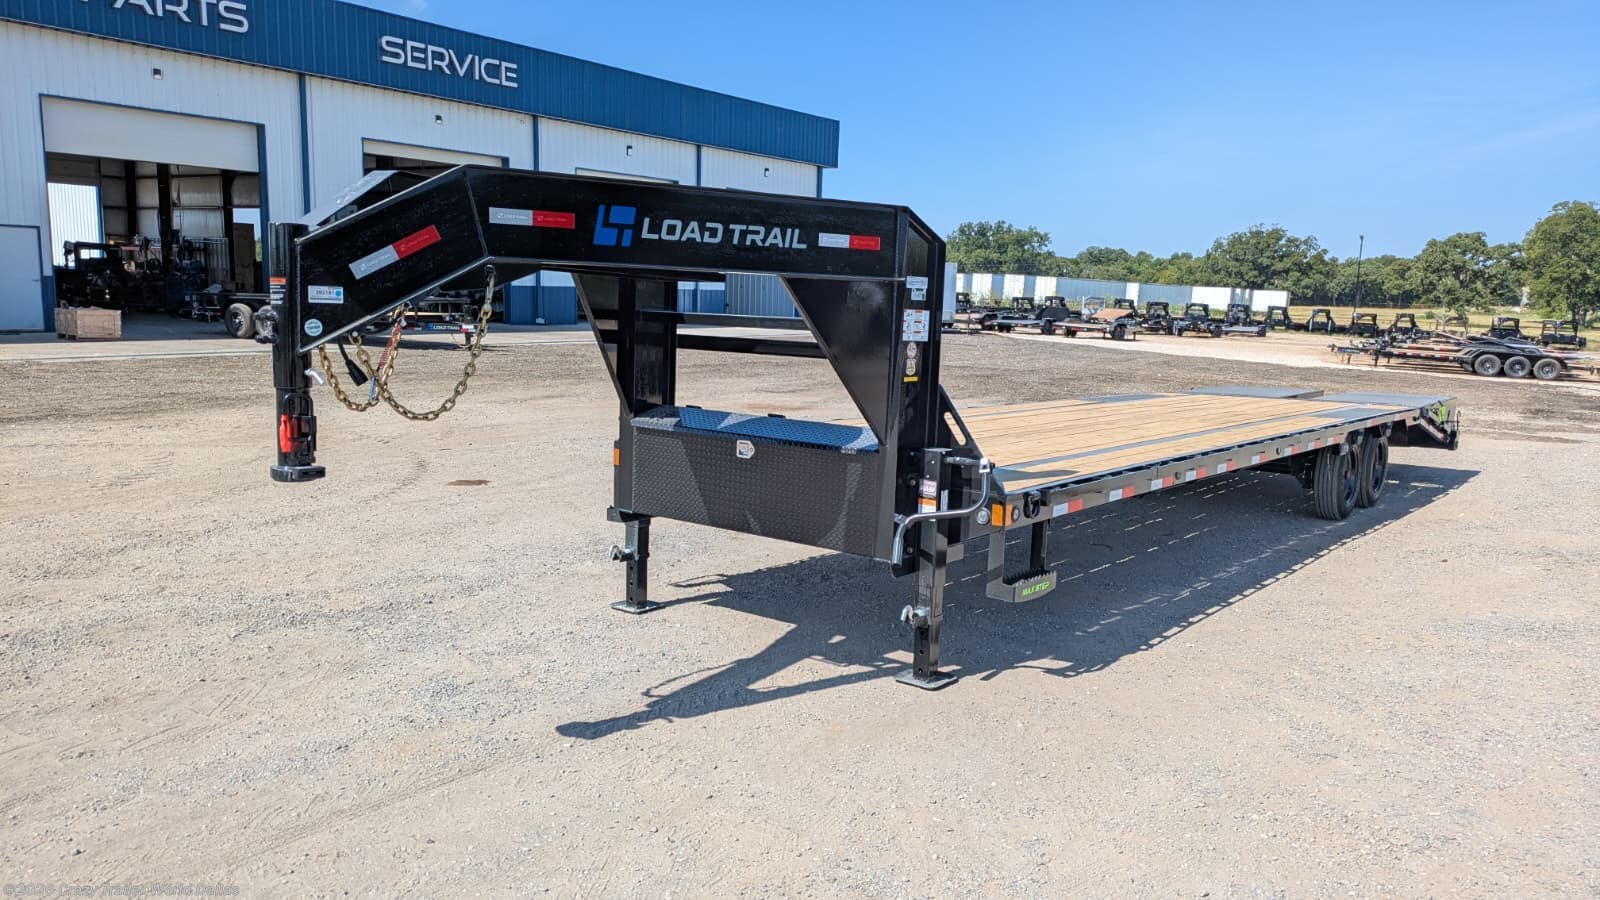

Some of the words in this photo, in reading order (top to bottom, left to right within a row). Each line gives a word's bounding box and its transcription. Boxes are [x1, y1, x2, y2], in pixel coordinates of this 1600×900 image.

[381, 35, 518, 88] SERVICE
[641, 217, 724, 244] LOAD
[729, 224, 807, 249] TRAIL
